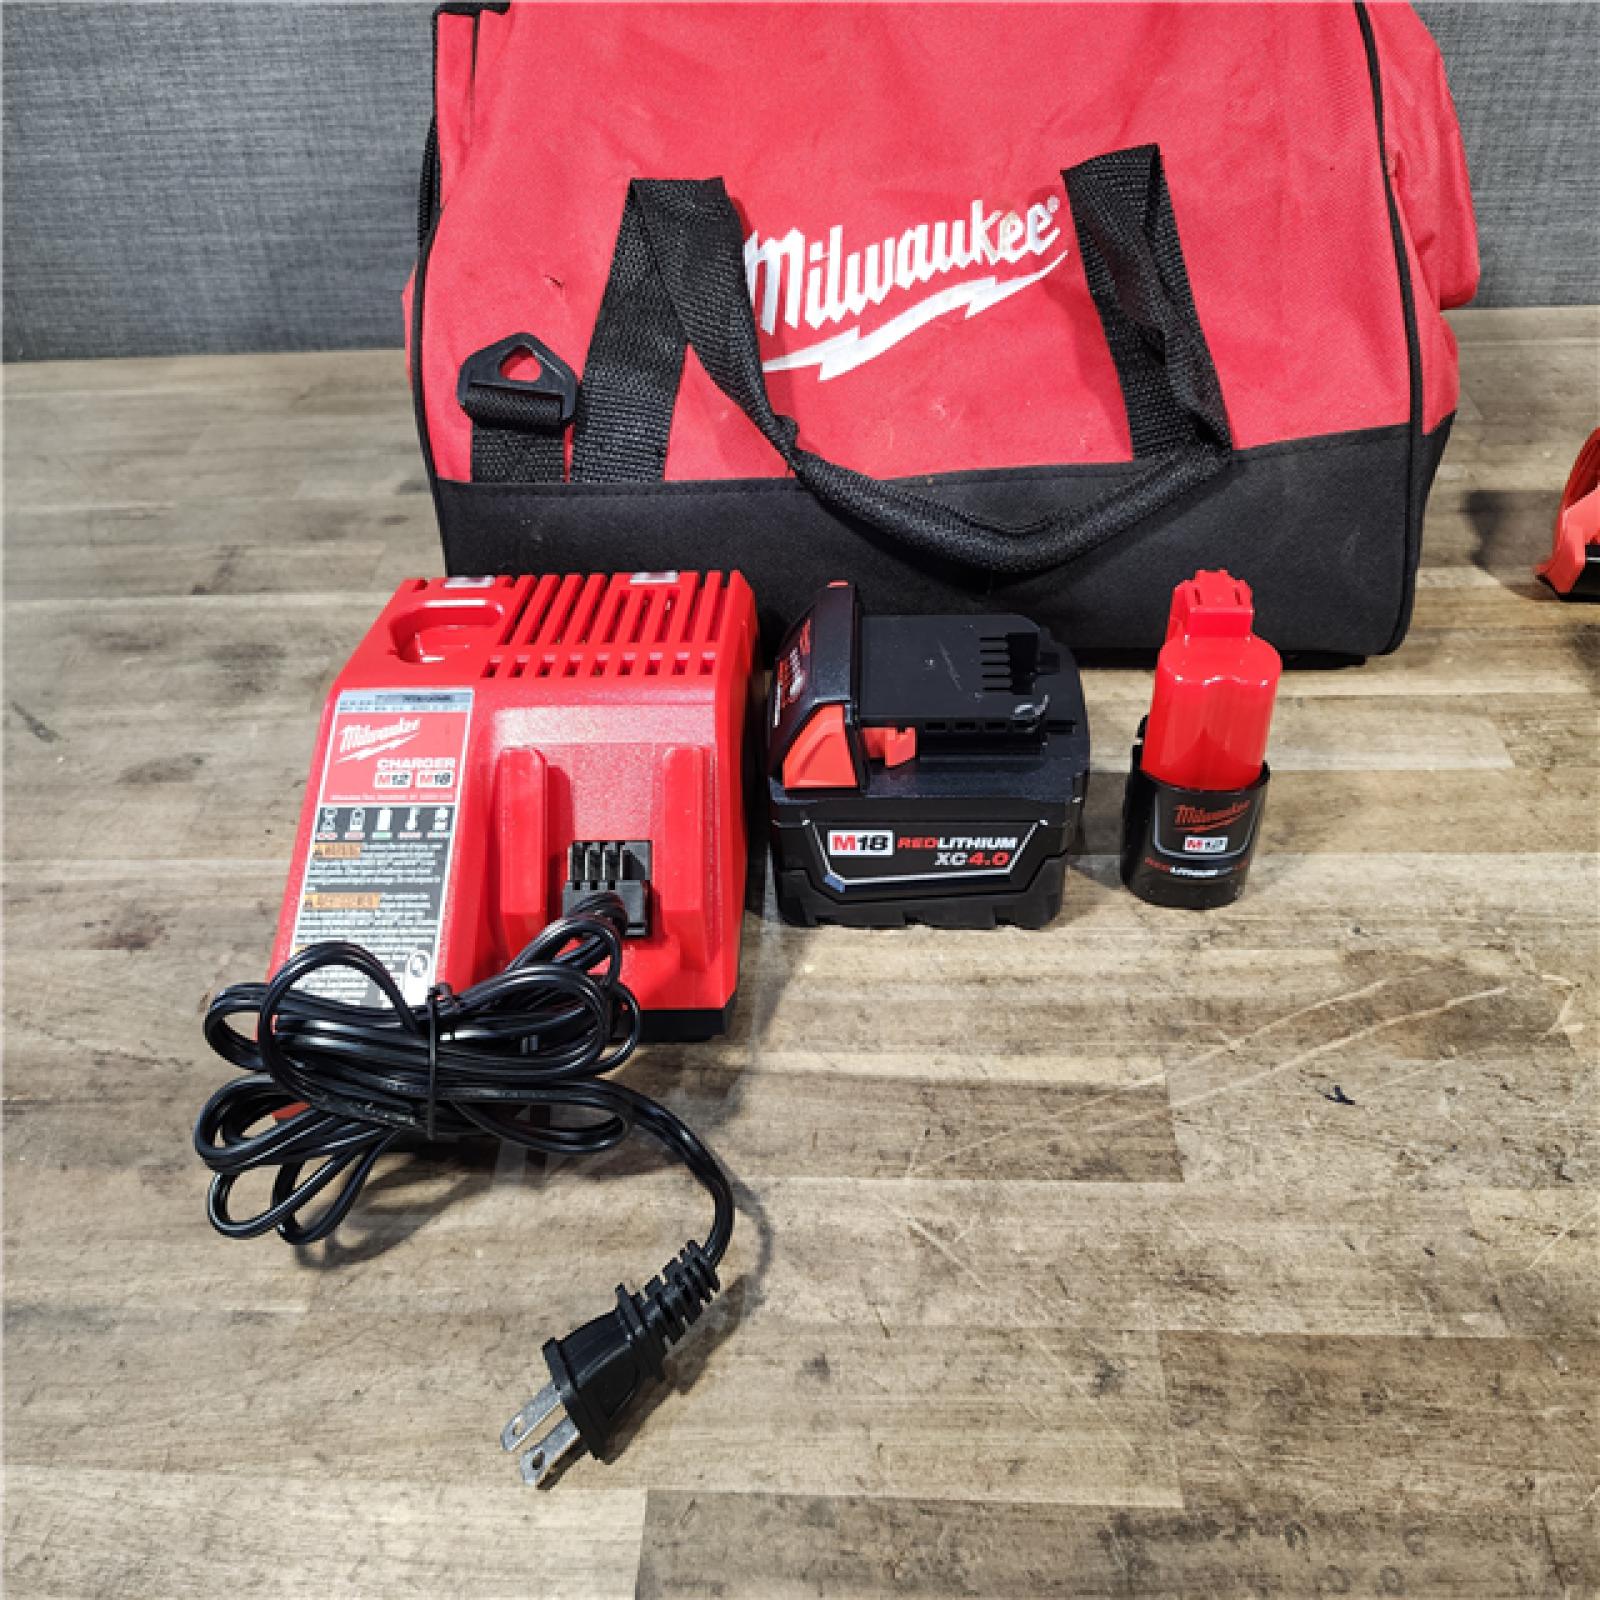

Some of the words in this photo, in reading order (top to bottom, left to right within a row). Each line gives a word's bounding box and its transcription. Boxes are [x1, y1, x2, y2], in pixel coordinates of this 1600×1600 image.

[376, 757, 456, 770] CHARGER
[831, 834, 891, 852] M18
[897, 836, 1018, 850] REDLITHIUM
